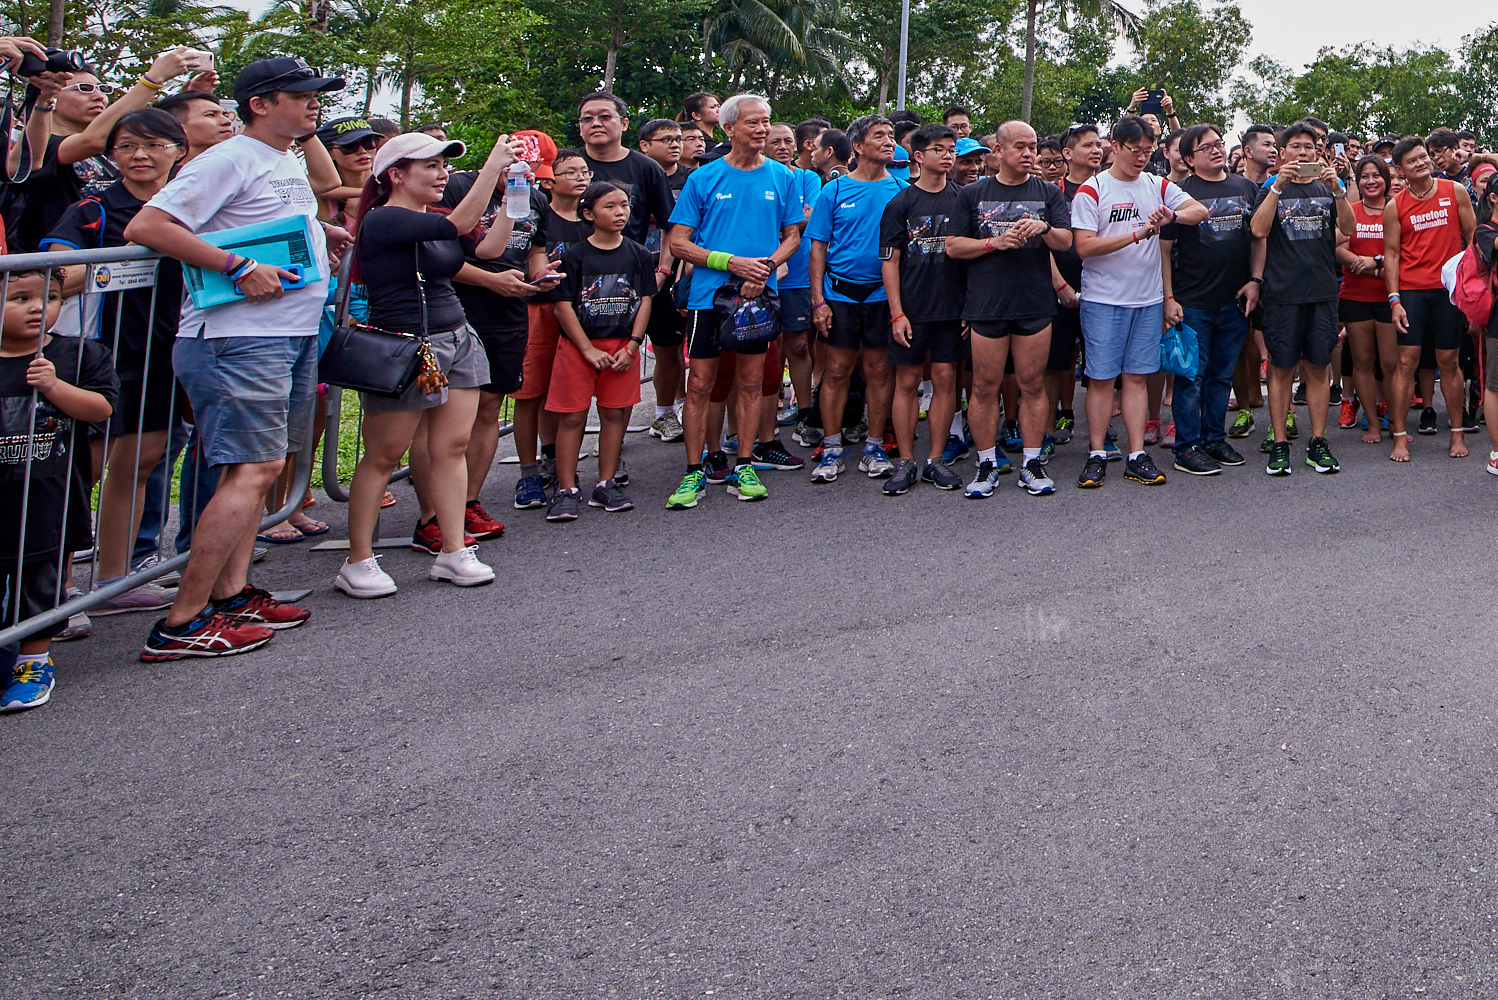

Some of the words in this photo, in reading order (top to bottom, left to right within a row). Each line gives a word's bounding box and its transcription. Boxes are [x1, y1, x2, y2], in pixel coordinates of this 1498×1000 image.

[1109, 208, 1132, 224] RUN
[1410, 208, 1449, 225] Barefoot
[1413, 218, 1448, 232] Minimalist
